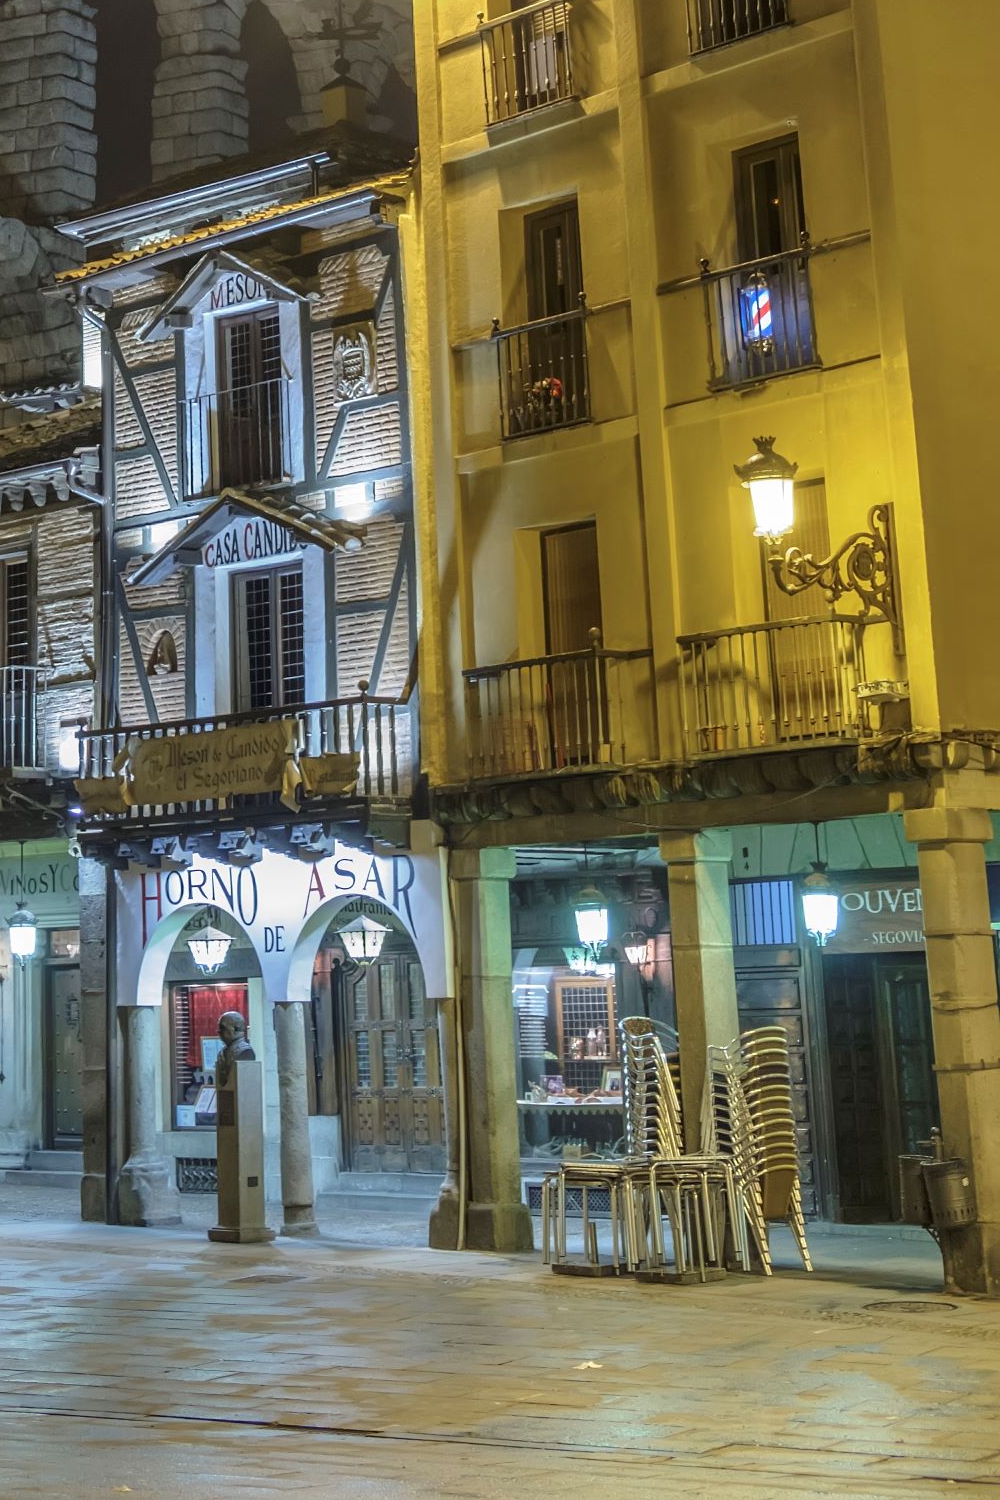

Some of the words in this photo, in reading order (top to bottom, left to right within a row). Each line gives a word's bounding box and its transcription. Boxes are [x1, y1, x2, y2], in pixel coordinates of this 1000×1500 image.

[204, 528, 241, 568] CASA
[244, 520, 307, 560] CANDID
[192, 765, 263, 793] Segoviano
[139, 864, 259, 950] HORNO
[264, 925, 286, 953] DE
[302, 854, 418, 940] ASAR
[840, 888, 923, 914] OUVE
